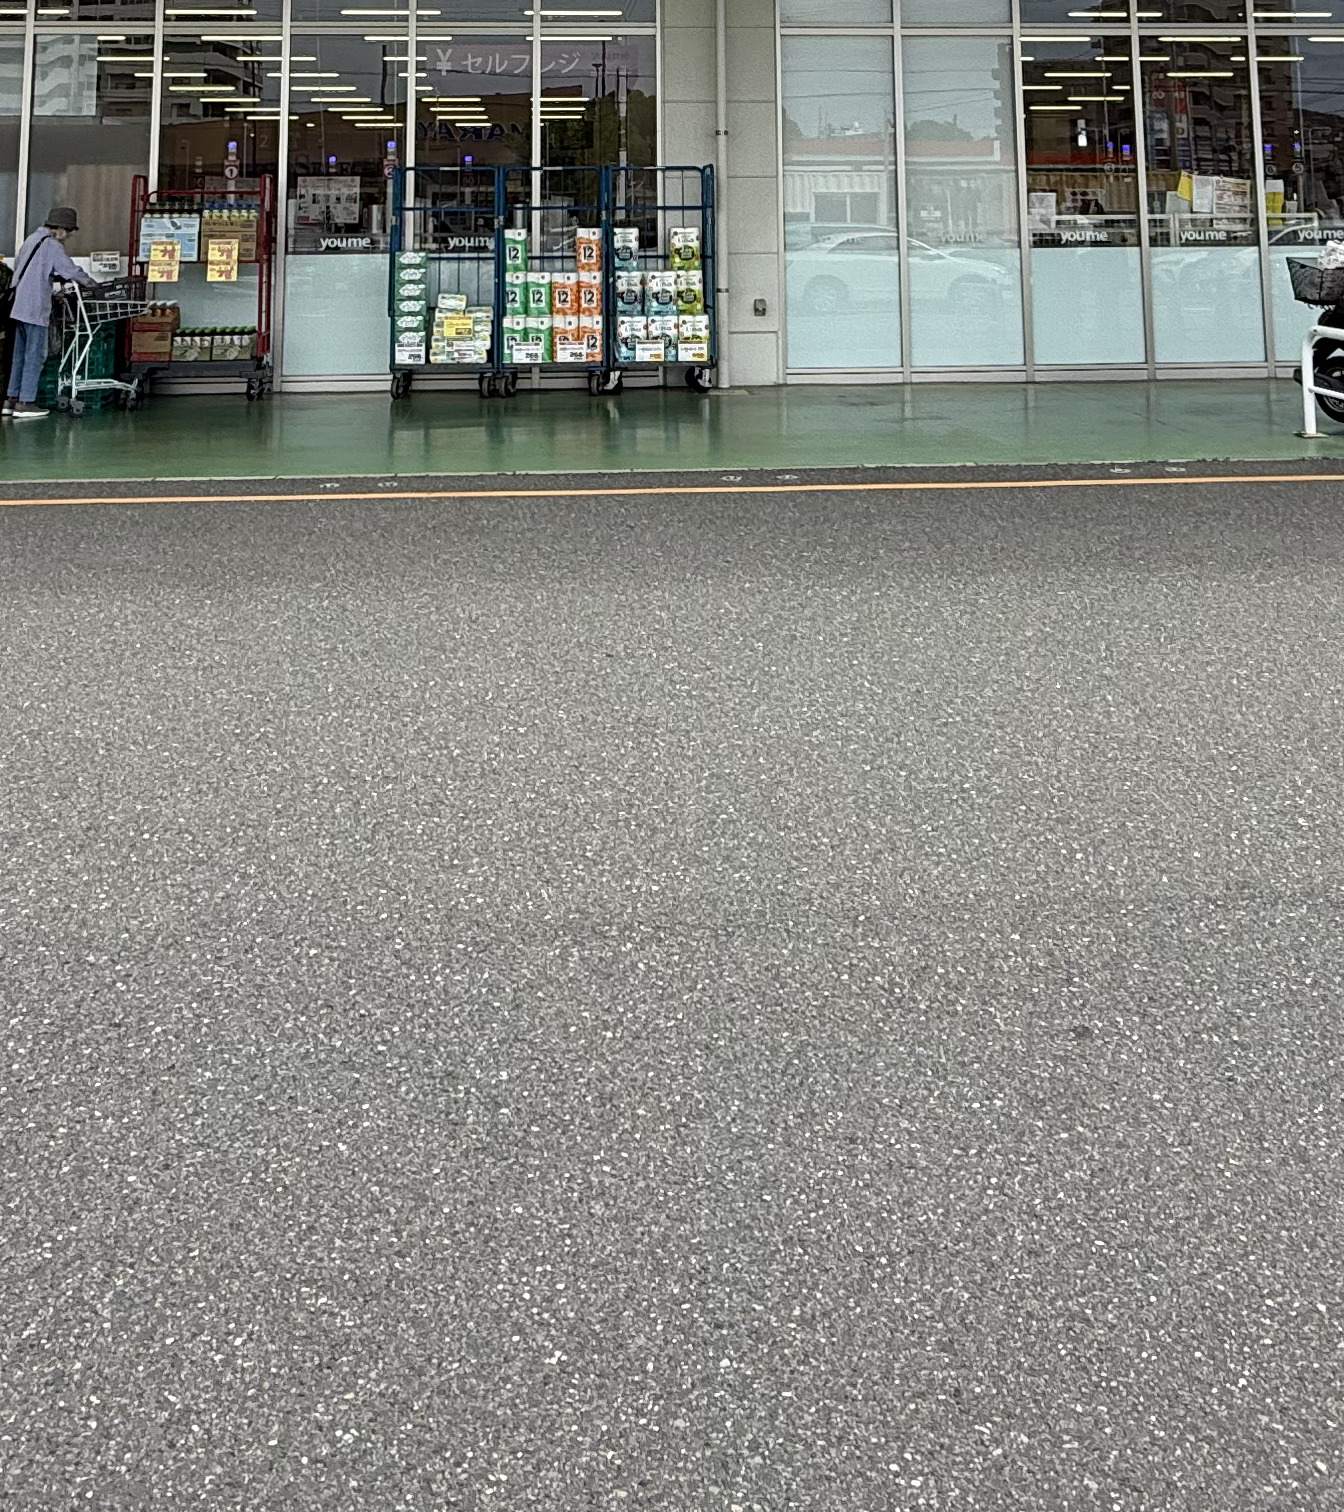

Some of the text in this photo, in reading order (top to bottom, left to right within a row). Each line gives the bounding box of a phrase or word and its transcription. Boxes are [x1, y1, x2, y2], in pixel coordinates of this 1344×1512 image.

[1060, 230, 1108, 244] youme
[1180, 230, 1227, 243] youme
[1297, 228, 1344, 242] youme
[320, 237, 371, 251] youme
[508, 246, 520, 260] 12
[583, 246, 595, 260] 12
[531, 290, 544, 304] 12
[558, 290, 569, 304] 12
[583, 290, 595, 304] 12
[586, 335, 598, 350] 12
